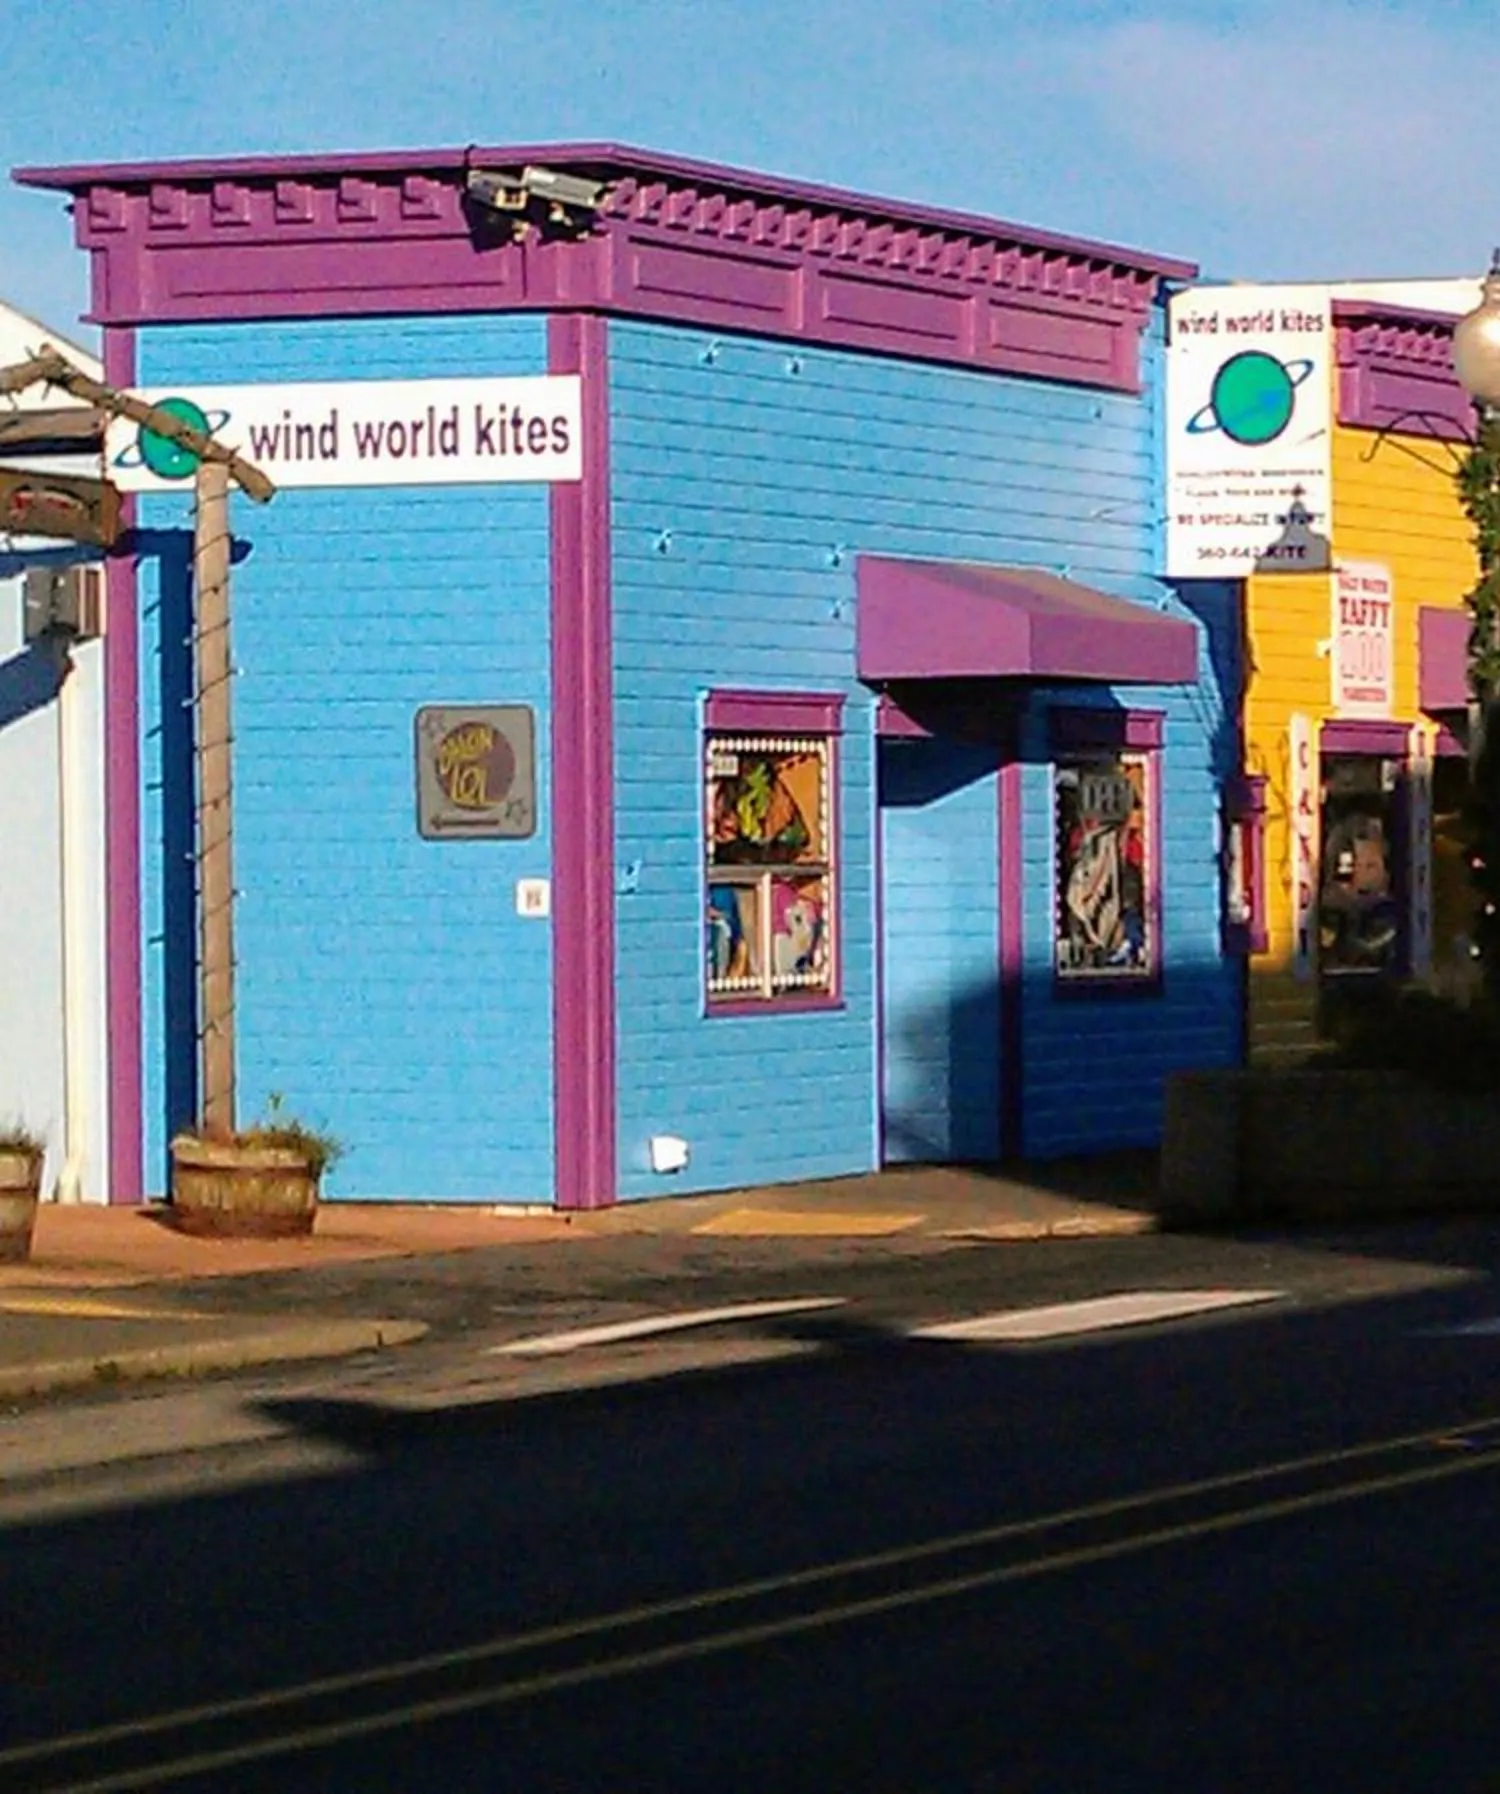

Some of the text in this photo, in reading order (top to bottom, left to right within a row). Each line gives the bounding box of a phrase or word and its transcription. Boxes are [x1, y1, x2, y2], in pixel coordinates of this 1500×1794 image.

[1178, 308, 1325, 334] wind world kites
[249, 403, 570, 461] wind world kites
